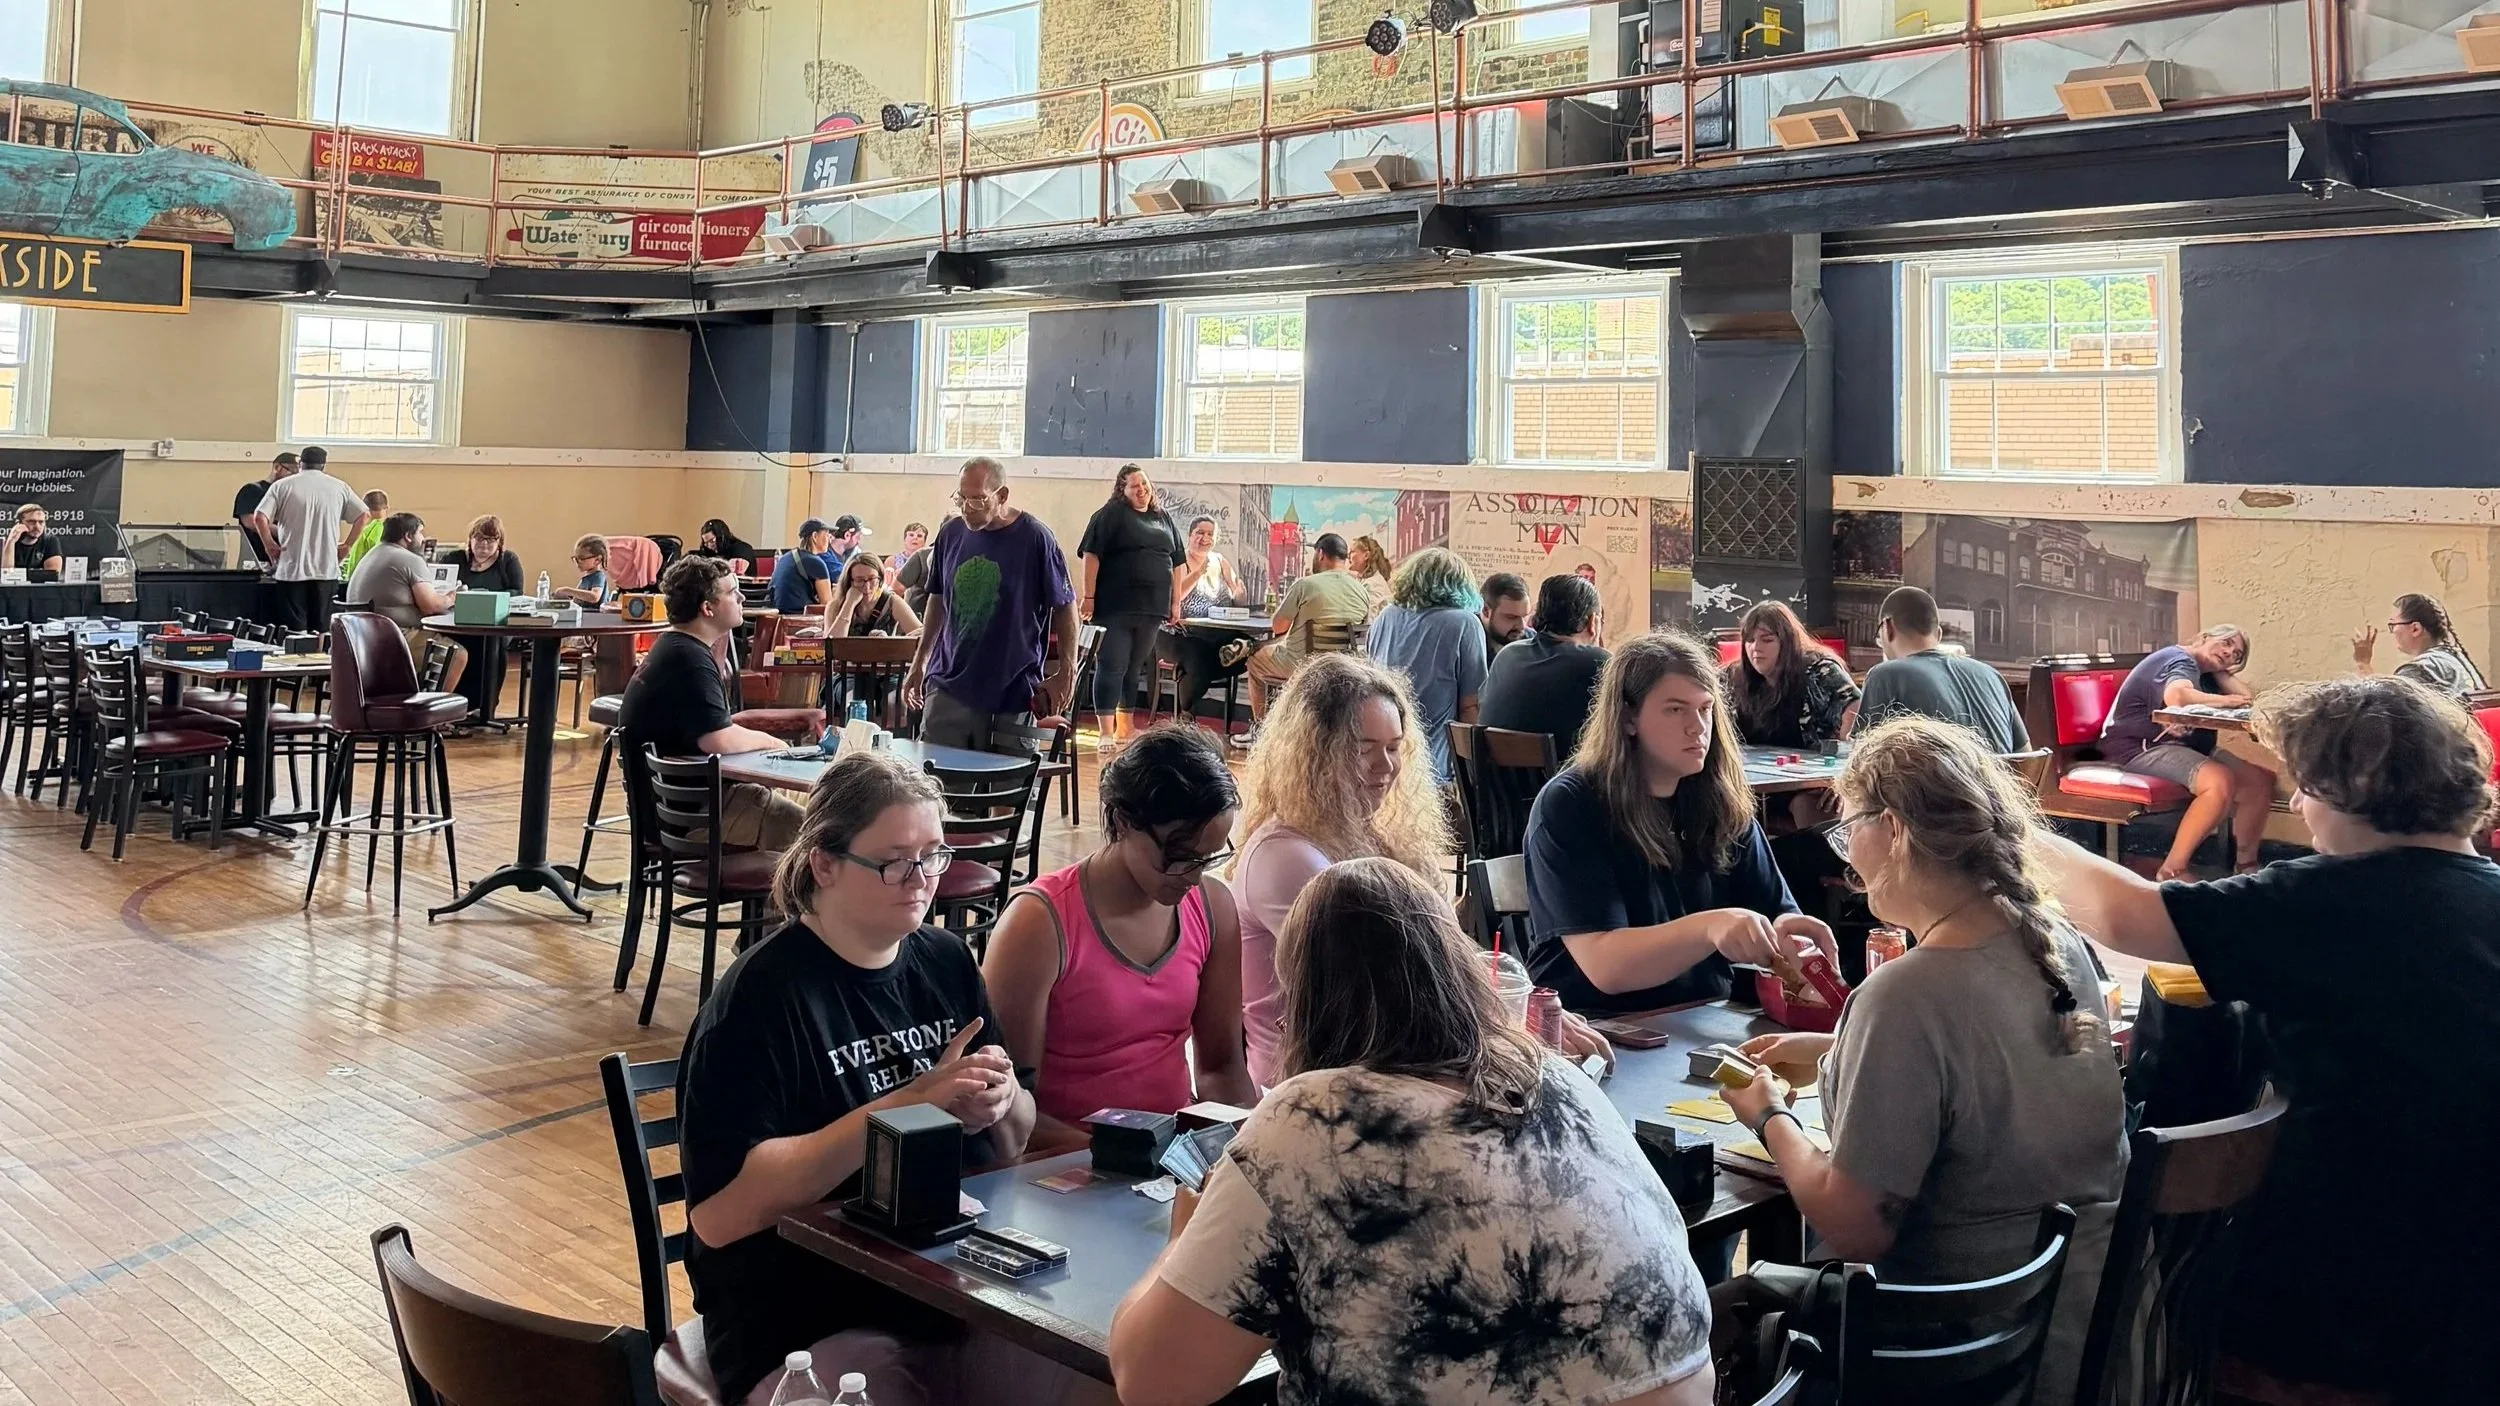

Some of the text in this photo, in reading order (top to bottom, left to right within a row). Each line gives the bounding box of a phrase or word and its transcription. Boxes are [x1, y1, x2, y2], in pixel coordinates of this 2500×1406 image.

[1090, 117, 1147, 150] CCi's
[191, 143, 215, 155] WE
[351, 141, 378, 155] RACK
[320, 150, 418, 174] GB A SLAB!
[813, 156, 839, 188] $5
[584, 189, 639, 198] ASSURANCE
[644, 191, 657, 199] OF
[660, 192, 710, 200] CONSTAT
[638, 219, 751, 237] air condtioners
[526, 225, 630, 251] Wateury
[639, 234, 703, 251] furnace
[0, 468, 86, 480] ur Imagination.
[26, 481, 76, 493] Hobbies.
[1466, 491, 1640, 518] ASSOCIATION
[74, 524, 95, 535] and
[1517, 522, 1581, 545] MEN
[827, 1018, 957, 1076] EVERYONE
